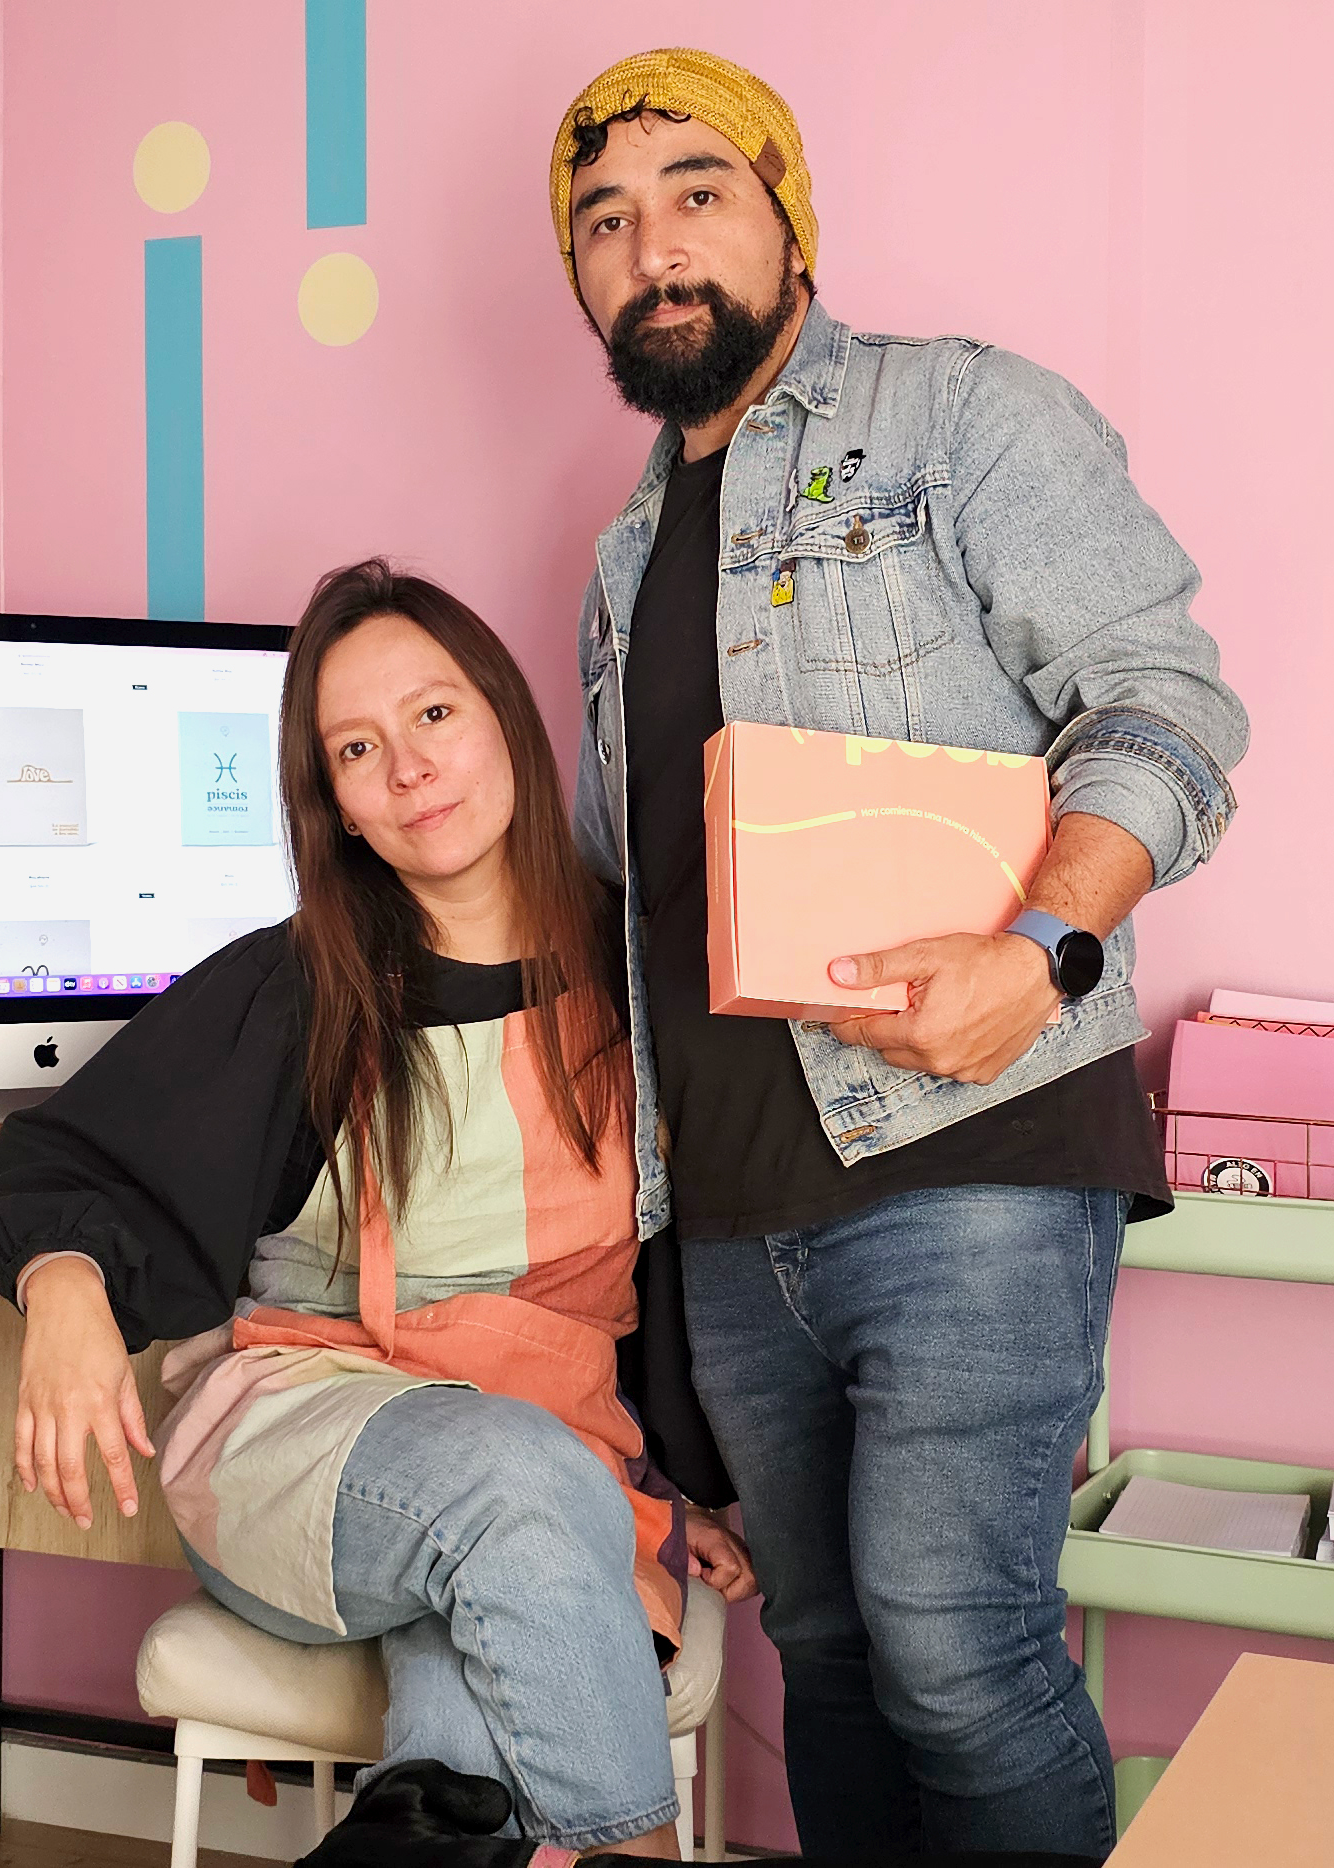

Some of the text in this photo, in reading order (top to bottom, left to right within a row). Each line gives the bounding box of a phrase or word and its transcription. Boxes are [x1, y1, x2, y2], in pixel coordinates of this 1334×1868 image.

[206, 788, 248, 802] piscis
[880, 806, 923, 818] comienza
[924, 811, 942, 823] una
[943, 817, 969, 835] nueva
[969, 830, 1000, 858] historia
